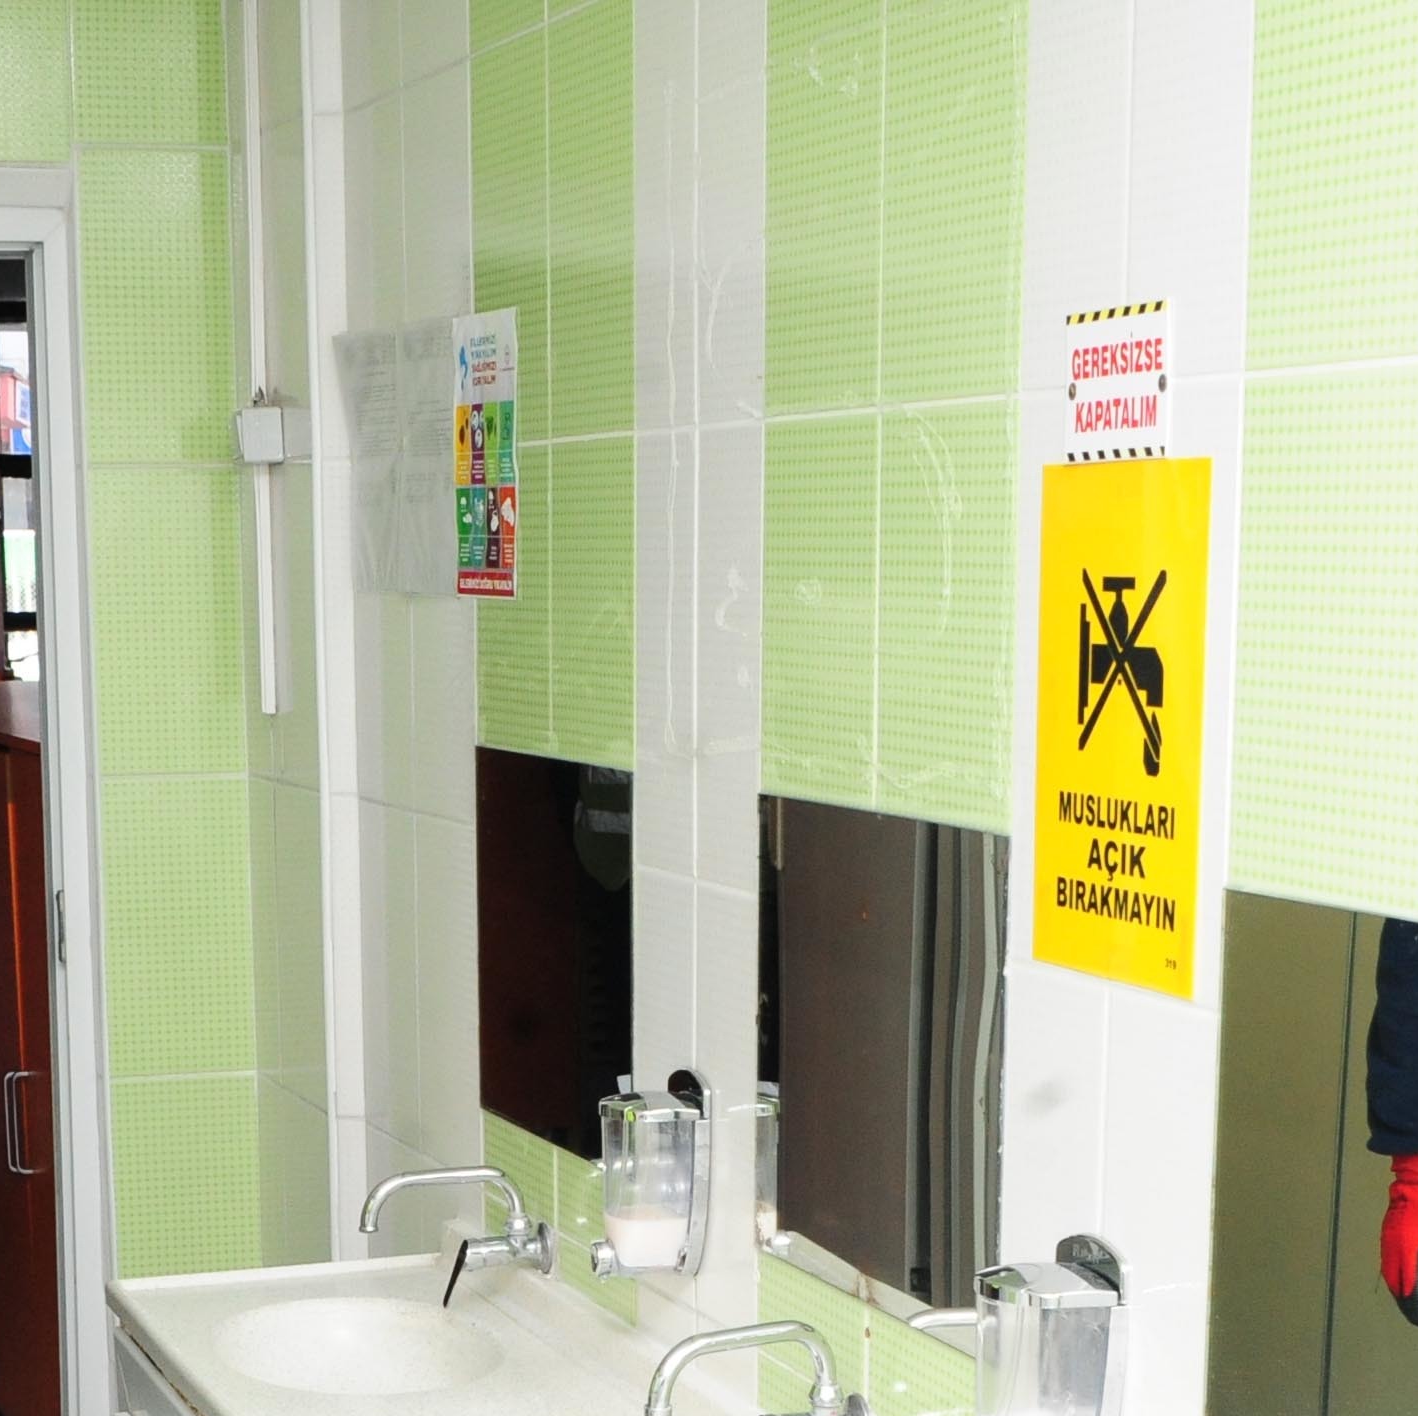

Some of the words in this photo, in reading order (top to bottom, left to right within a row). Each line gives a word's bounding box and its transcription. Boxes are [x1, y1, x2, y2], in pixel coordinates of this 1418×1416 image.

[1075, 394, 1158, 433] KAPATALIM
[1058, 790, 1175, 841] MUSLUKLARI
[1087, 838, 1146, 882] AÇIK
[1056, 876, 1176, 933] BIRAKMAYIN
